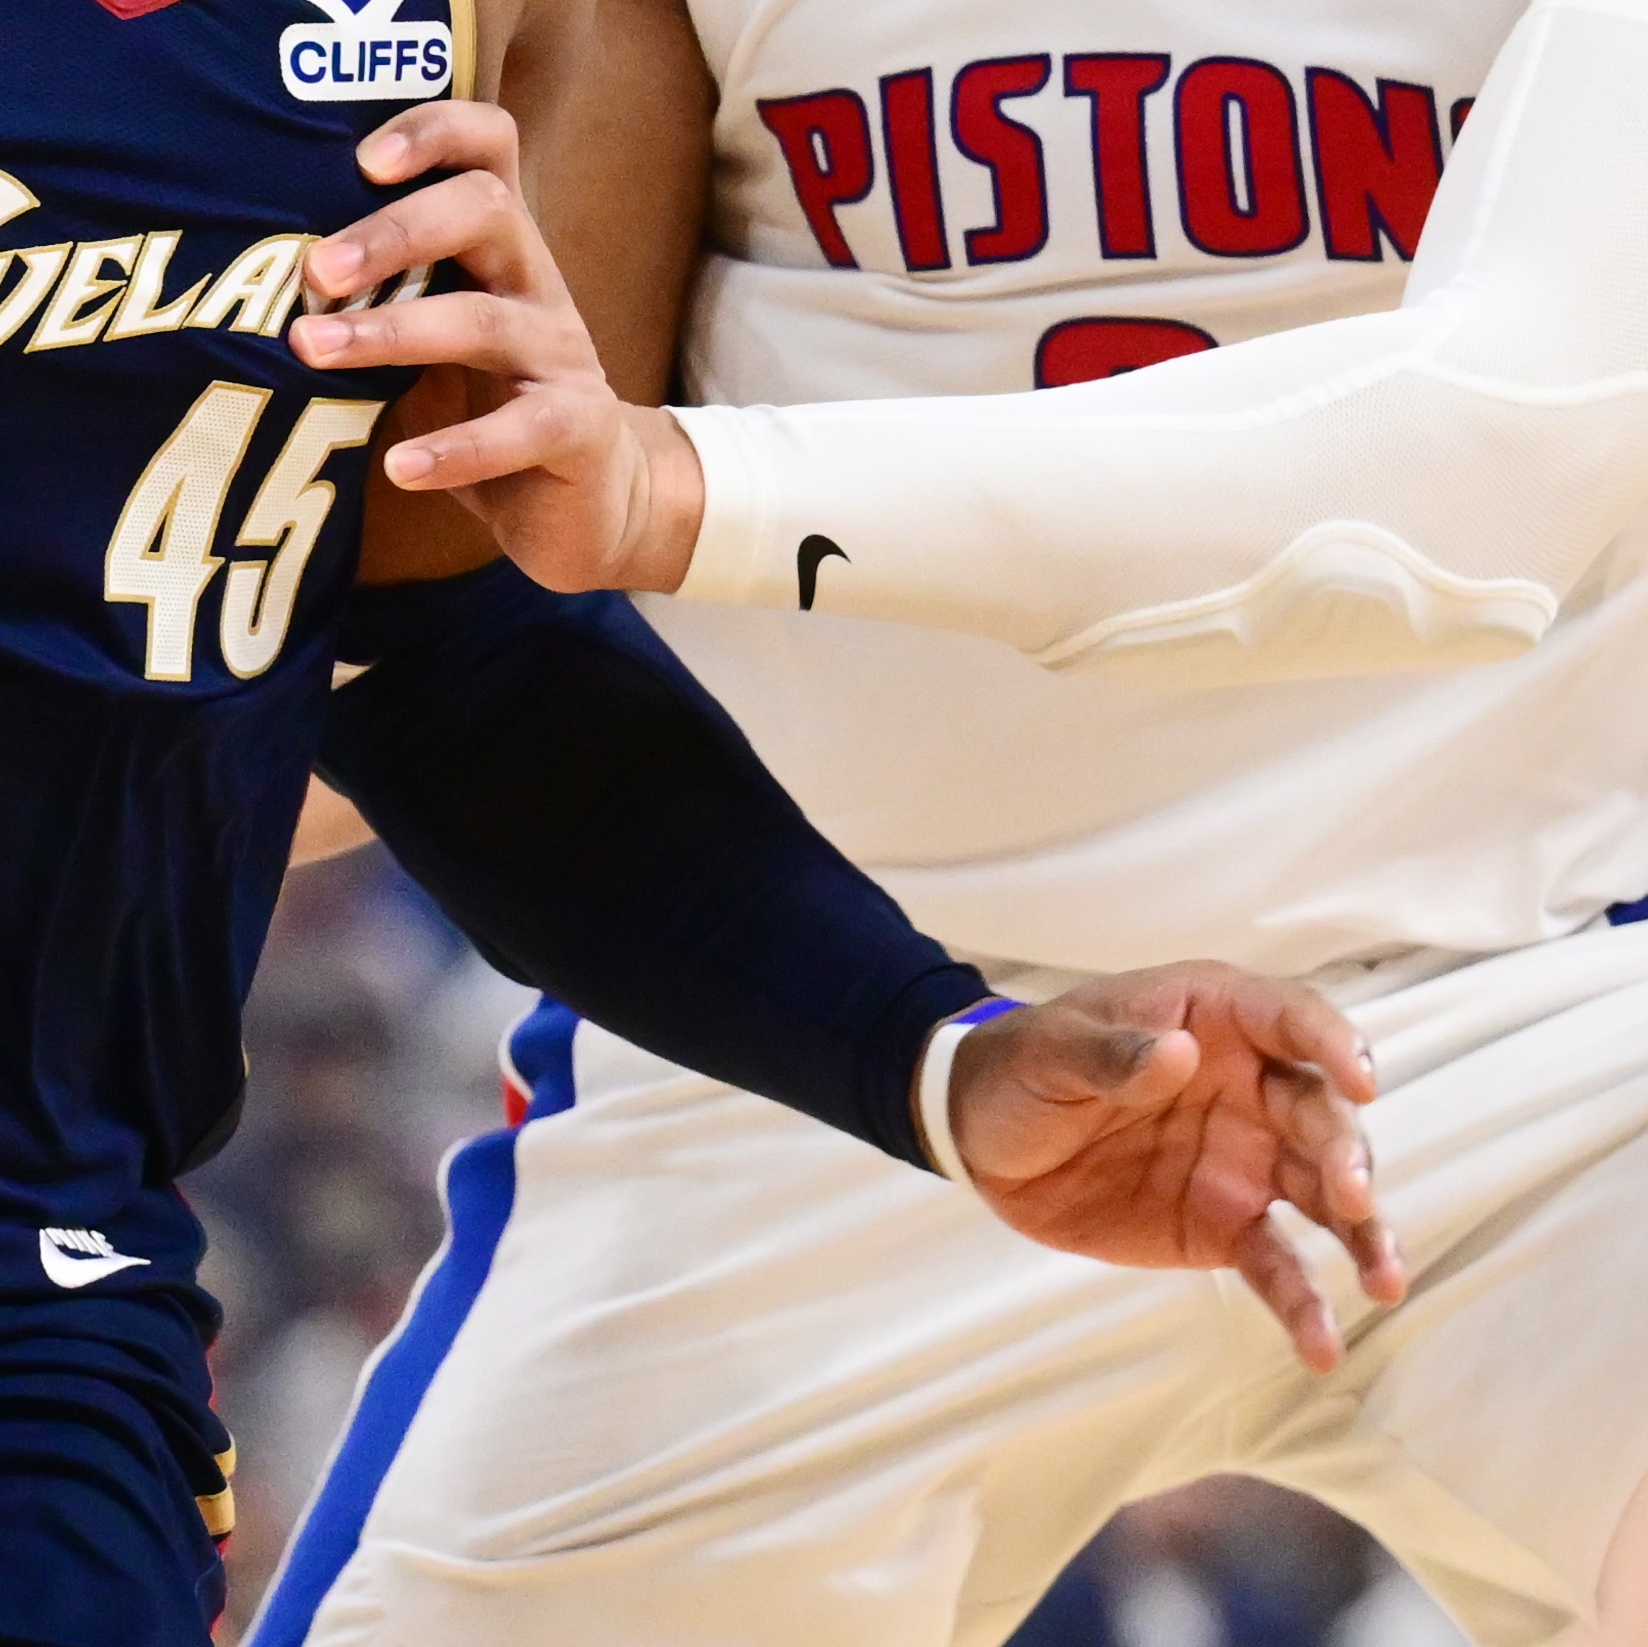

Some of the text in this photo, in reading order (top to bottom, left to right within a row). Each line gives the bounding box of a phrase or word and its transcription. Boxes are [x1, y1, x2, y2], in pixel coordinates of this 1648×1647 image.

[290, 38, 448, 84] CLIFFS
[756, 51, 1476, 271] PISTON
[104, 380, 390, 682] 45
